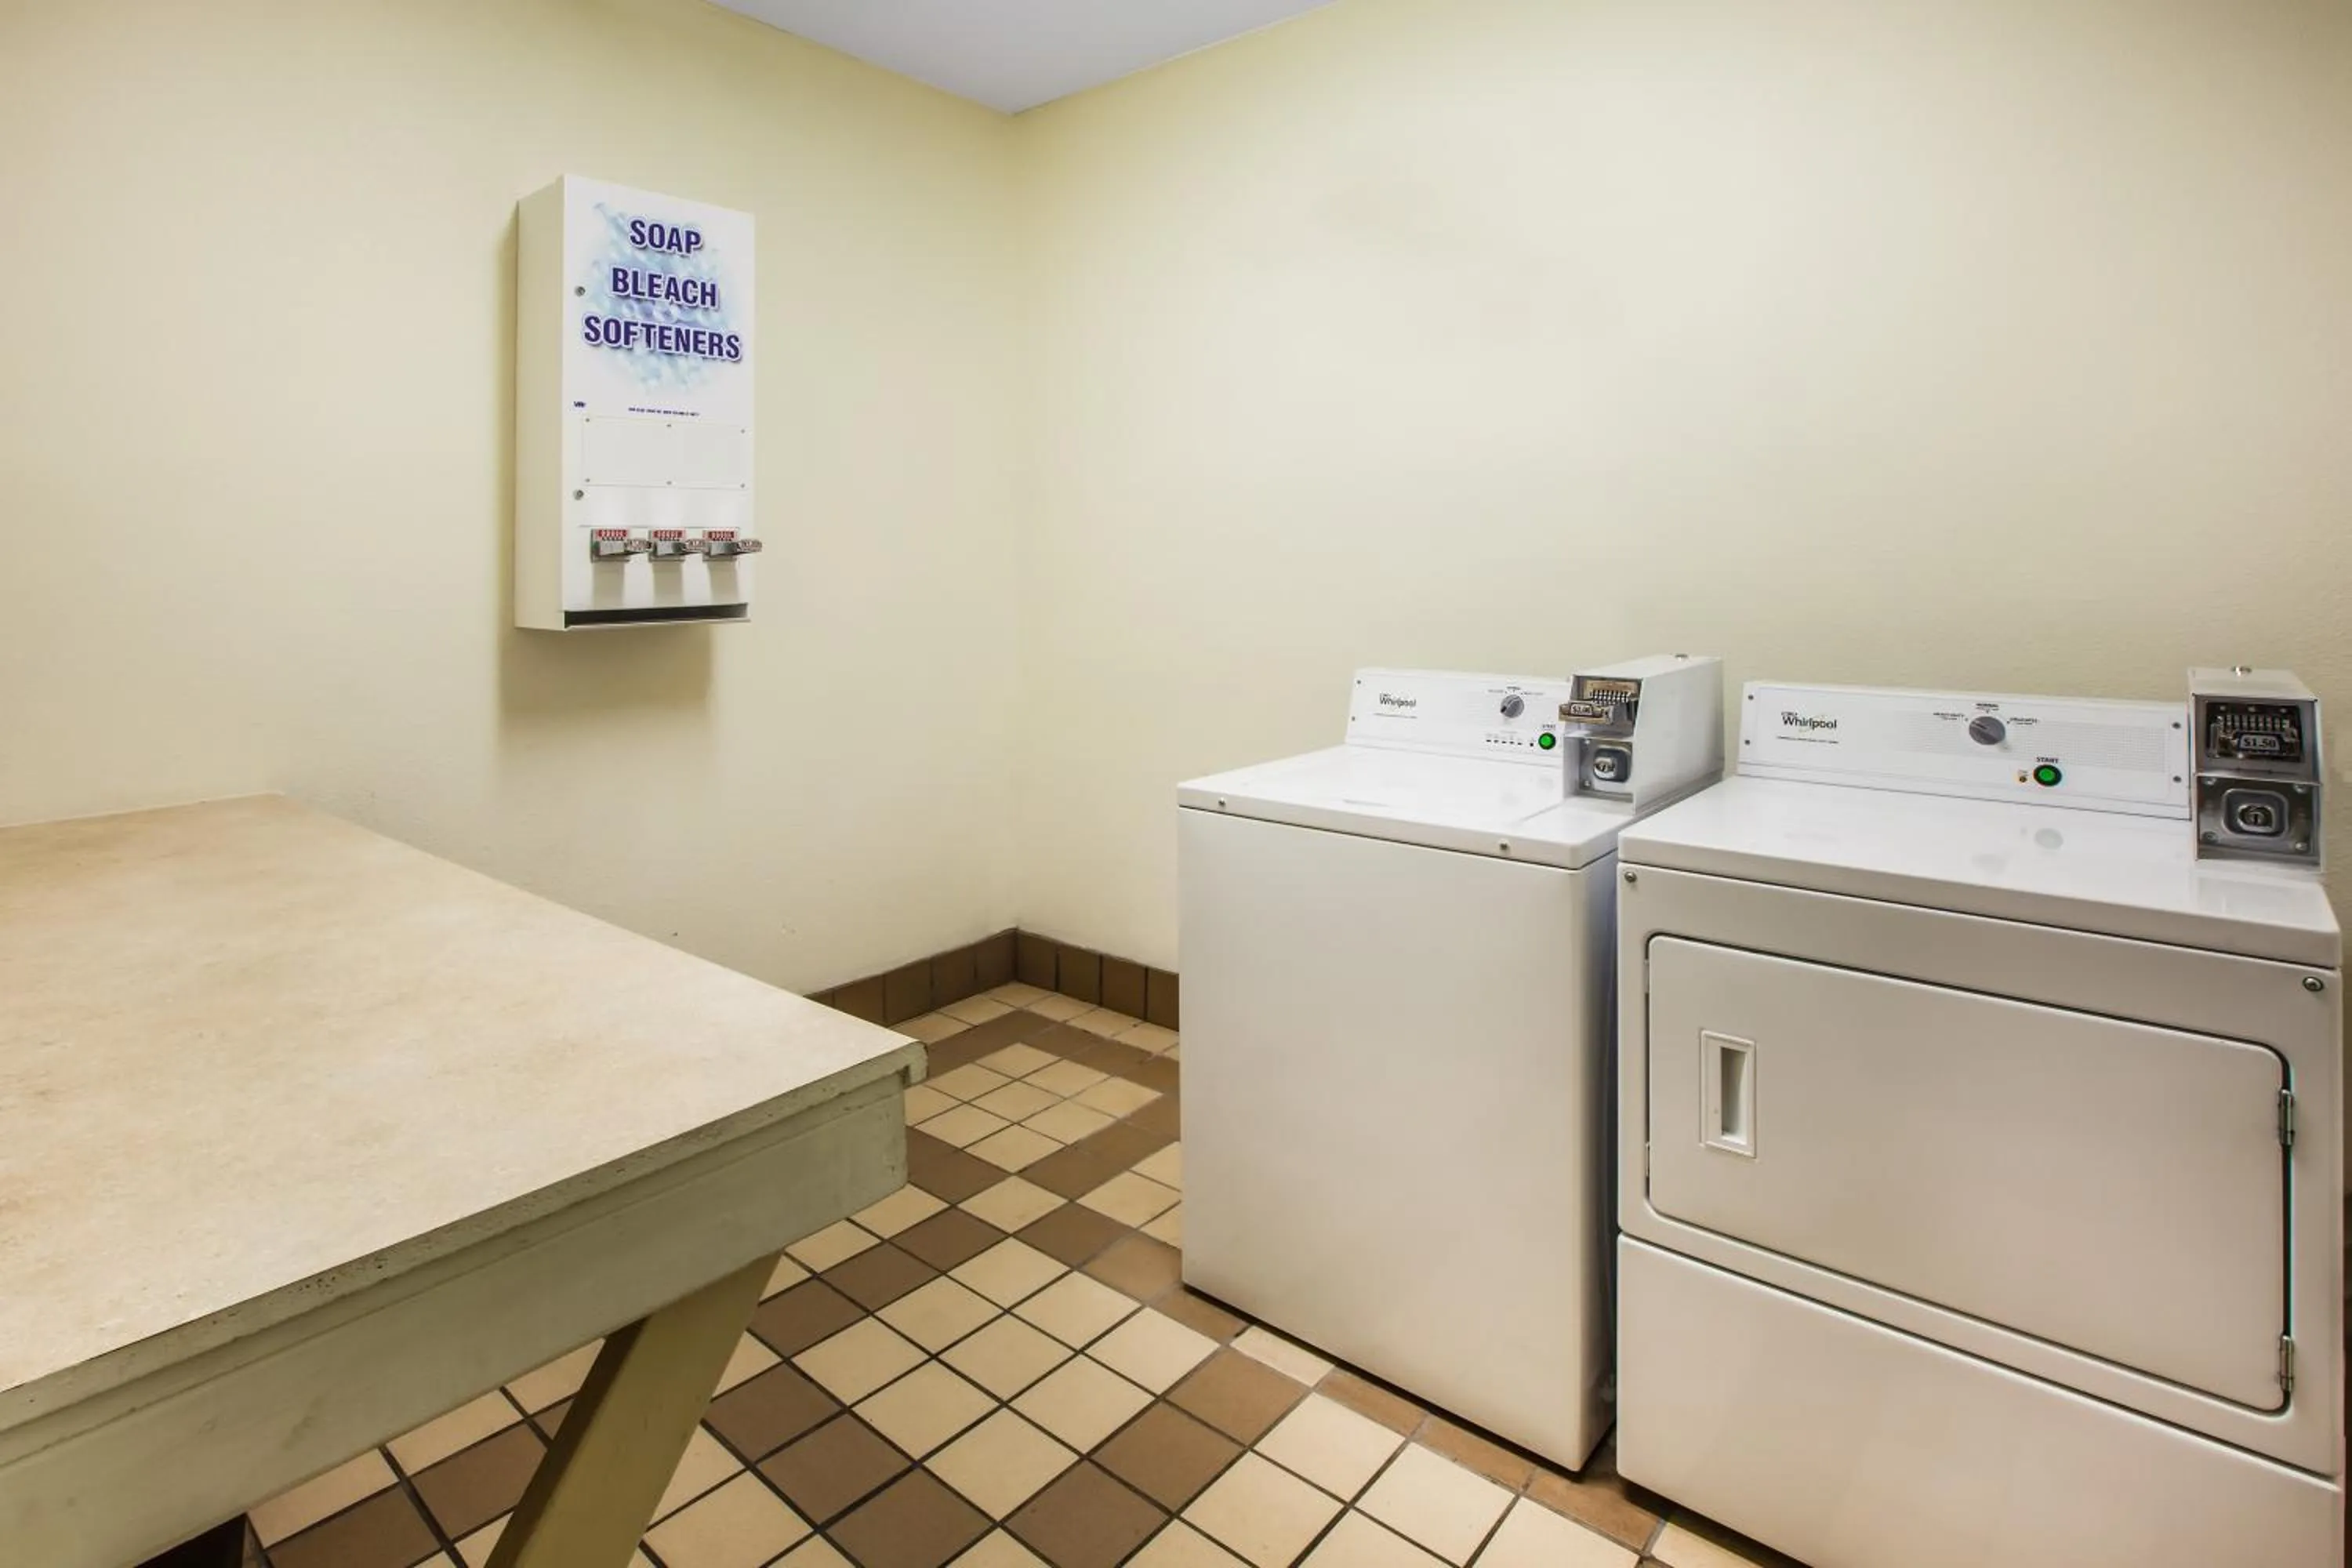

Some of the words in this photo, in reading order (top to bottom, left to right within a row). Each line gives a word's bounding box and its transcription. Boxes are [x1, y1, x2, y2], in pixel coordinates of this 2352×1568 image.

[630, 220, 702, 254] SOAP
[612, 267, 717, 307] BLEACH
[584, 315, 740, 359] SOFTENERS
[1379, 693, 1417, 709] Whirlpool
[1781, 714, 1837, 731] Whirlpool
